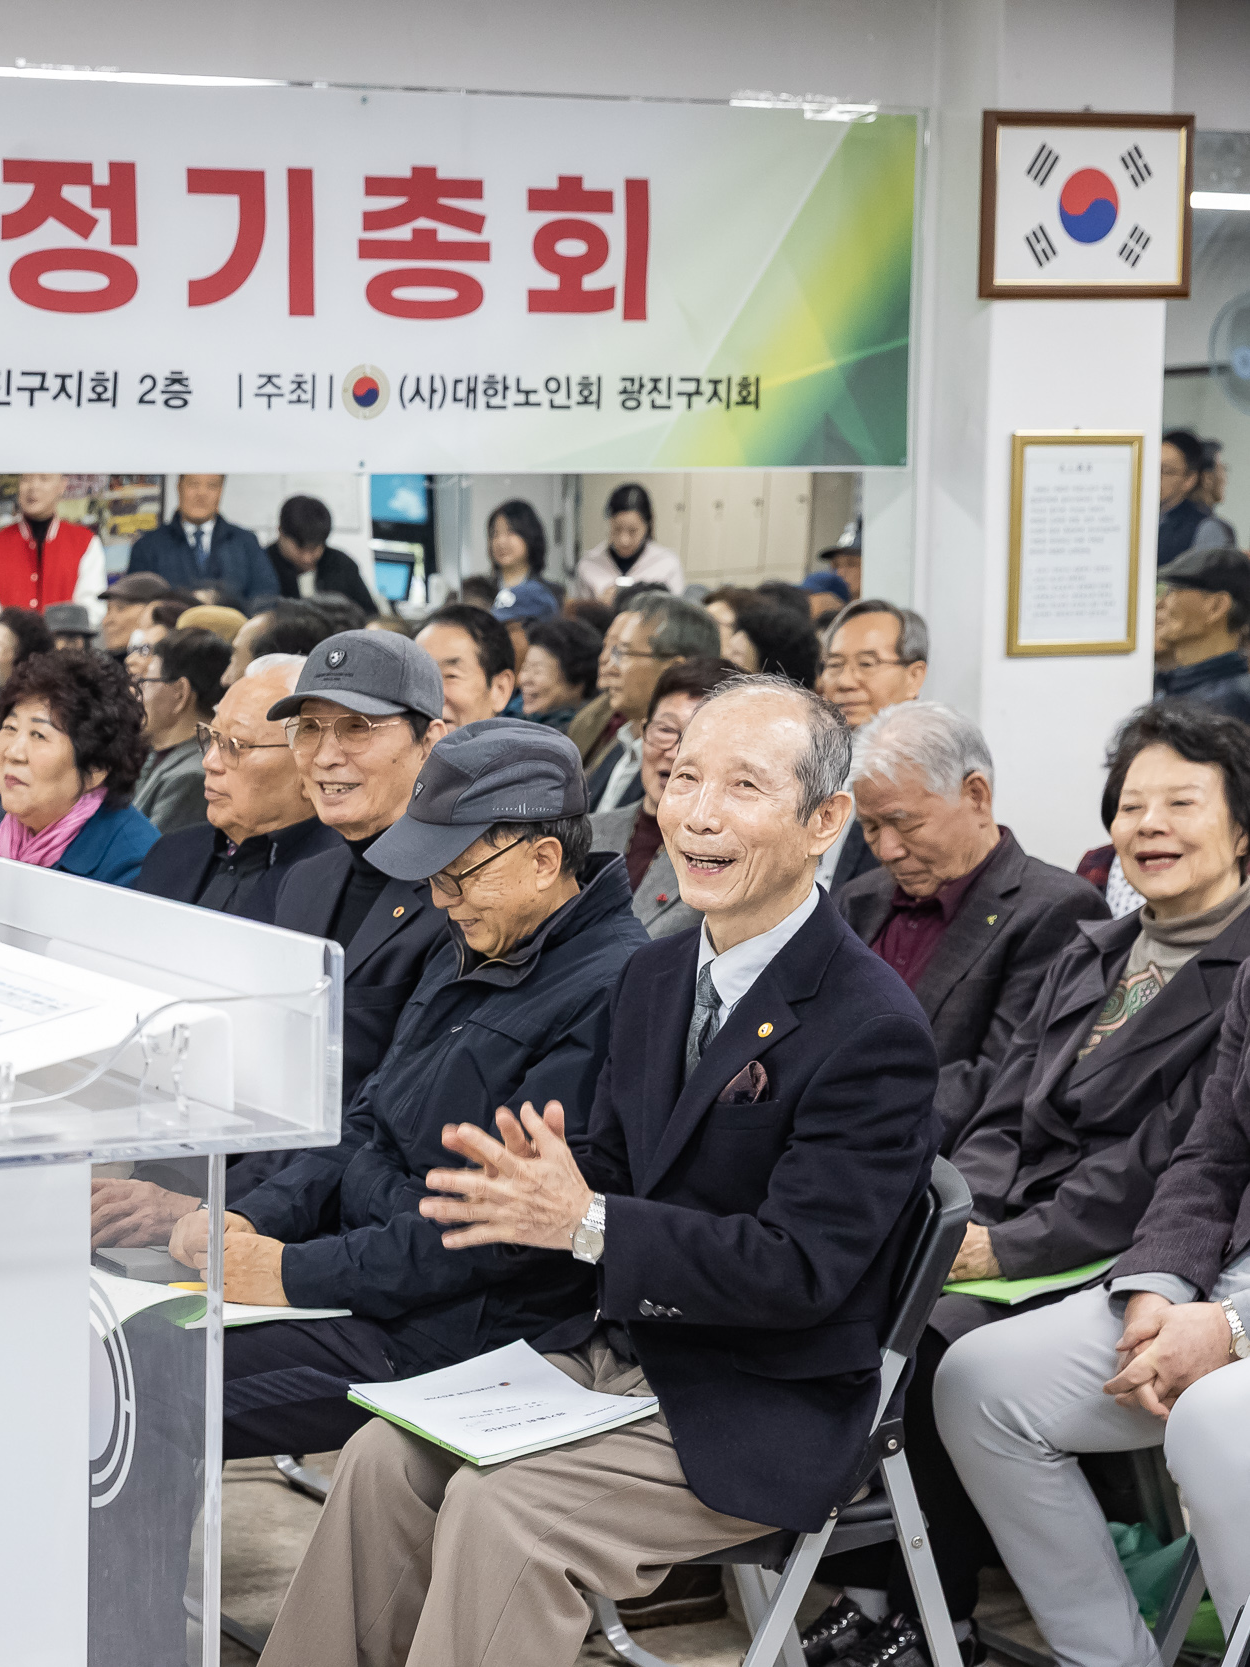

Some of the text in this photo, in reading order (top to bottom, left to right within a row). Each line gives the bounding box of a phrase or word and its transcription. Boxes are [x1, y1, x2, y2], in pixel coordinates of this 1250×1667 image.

[0, 158, 650, 322] 정기총회
[138, 371, 193, 410] 2층
[398, 374, 602, 411] (사)대한노인회
[617, 374, 762, 412] 광진구지회
